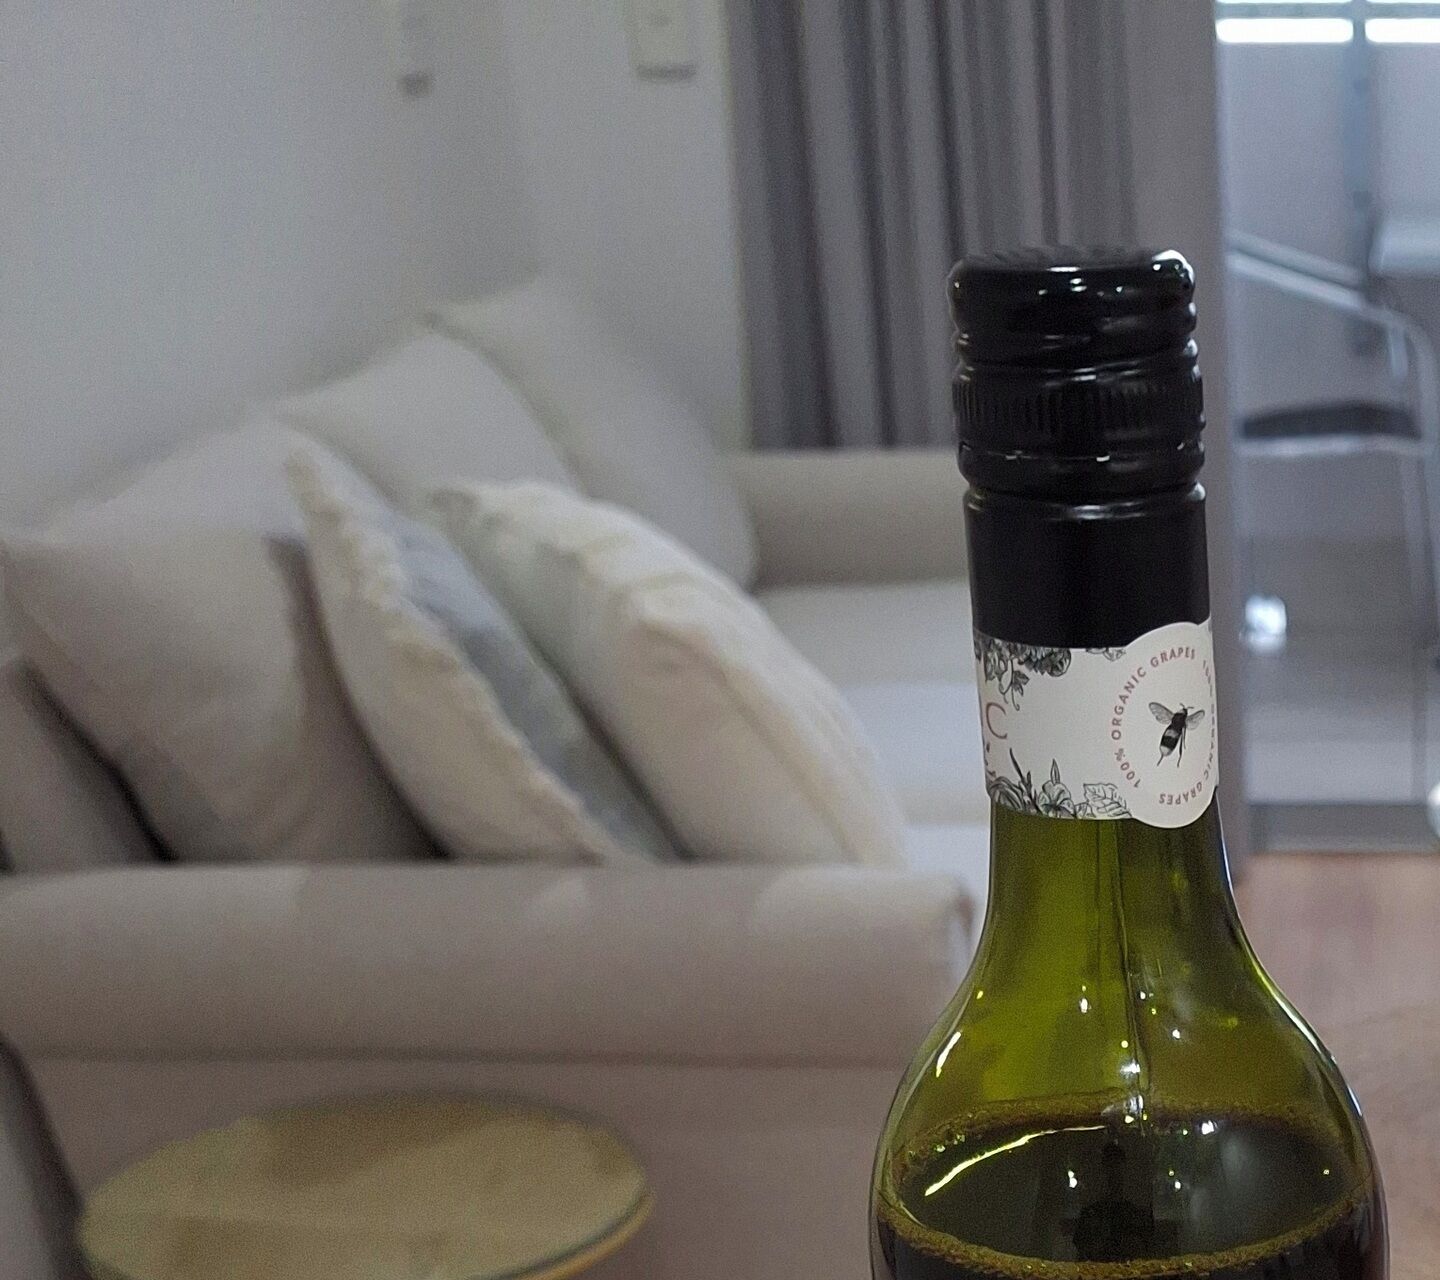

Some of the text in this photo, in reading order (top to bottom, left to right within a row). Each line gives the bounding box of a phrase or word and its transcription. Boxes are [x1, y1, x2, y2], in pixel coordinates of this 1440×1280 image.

[1111, 646, 1196, 789] 100% ORGANIC GRAPES
[1158, 781, 1203, 806] GRAPES
